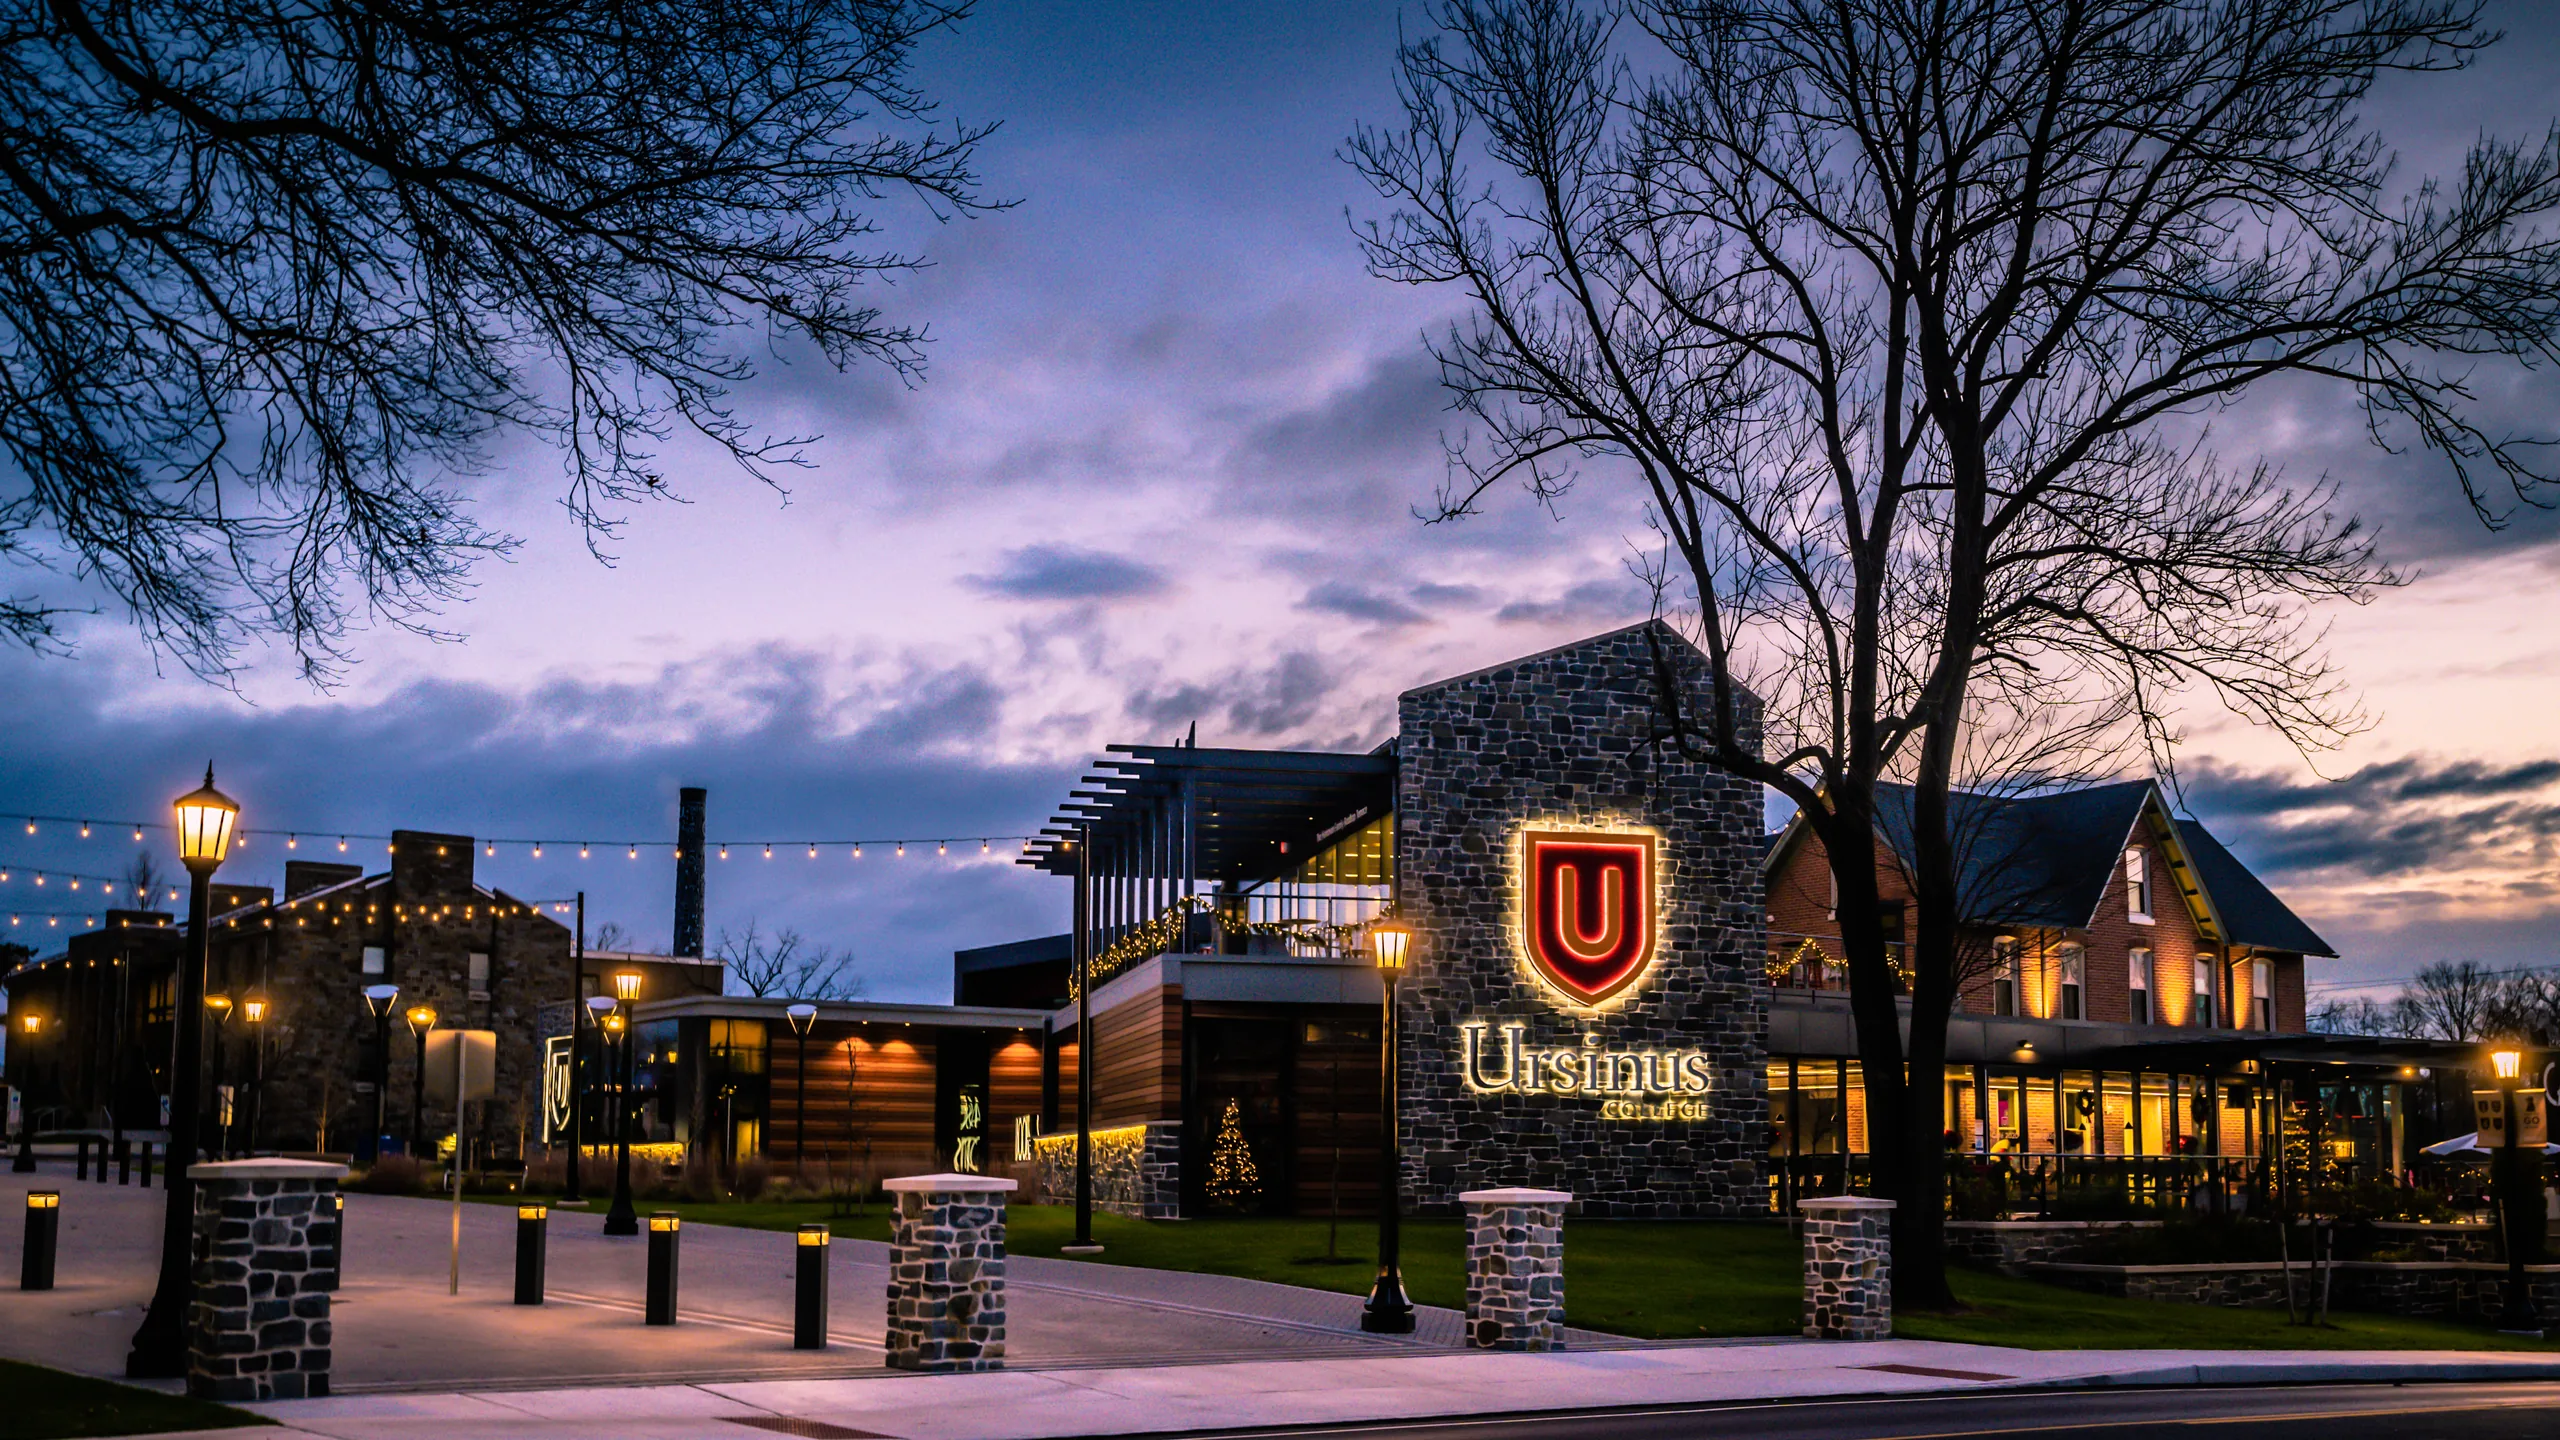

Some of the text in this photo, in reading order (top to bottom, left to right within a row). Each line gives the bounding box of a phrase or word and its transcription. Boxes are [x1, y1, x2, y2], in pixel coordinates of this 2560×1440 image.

[1558, 866, 1621, 956] U
[1464, 1025, 1710, 1092] Ursinus
[1606, 1102, 1710, 1118] COLLEGE
